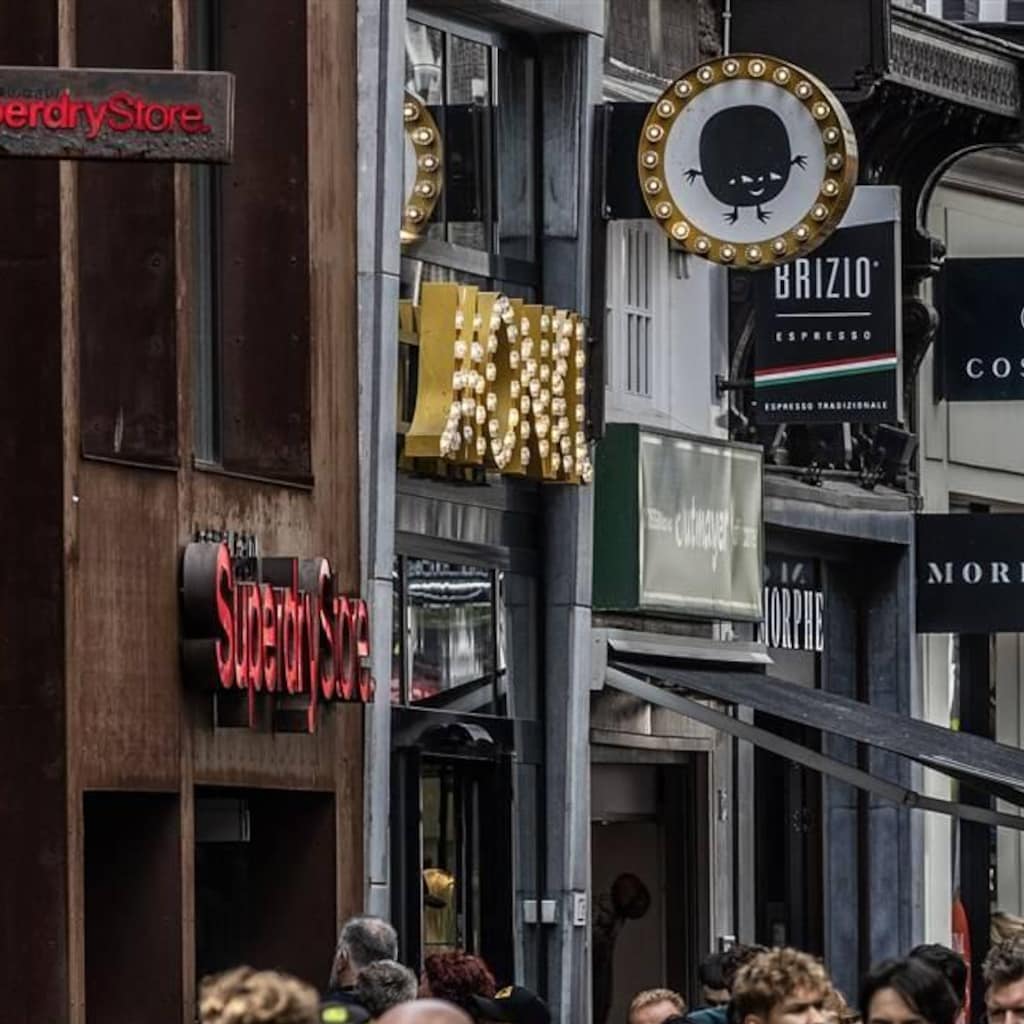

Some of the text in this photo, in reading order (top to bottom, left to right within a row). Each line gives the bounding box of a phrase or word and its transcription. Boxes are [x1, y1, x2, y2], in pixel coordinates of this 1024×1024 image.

[775, 256, 871, 299] BRIZIO
[775, 331, 872, 342] ESPRESSO
[764, 401, 814, 412] ESPRESSO
[816, 400, 888, 411] TRADIZIONALE
